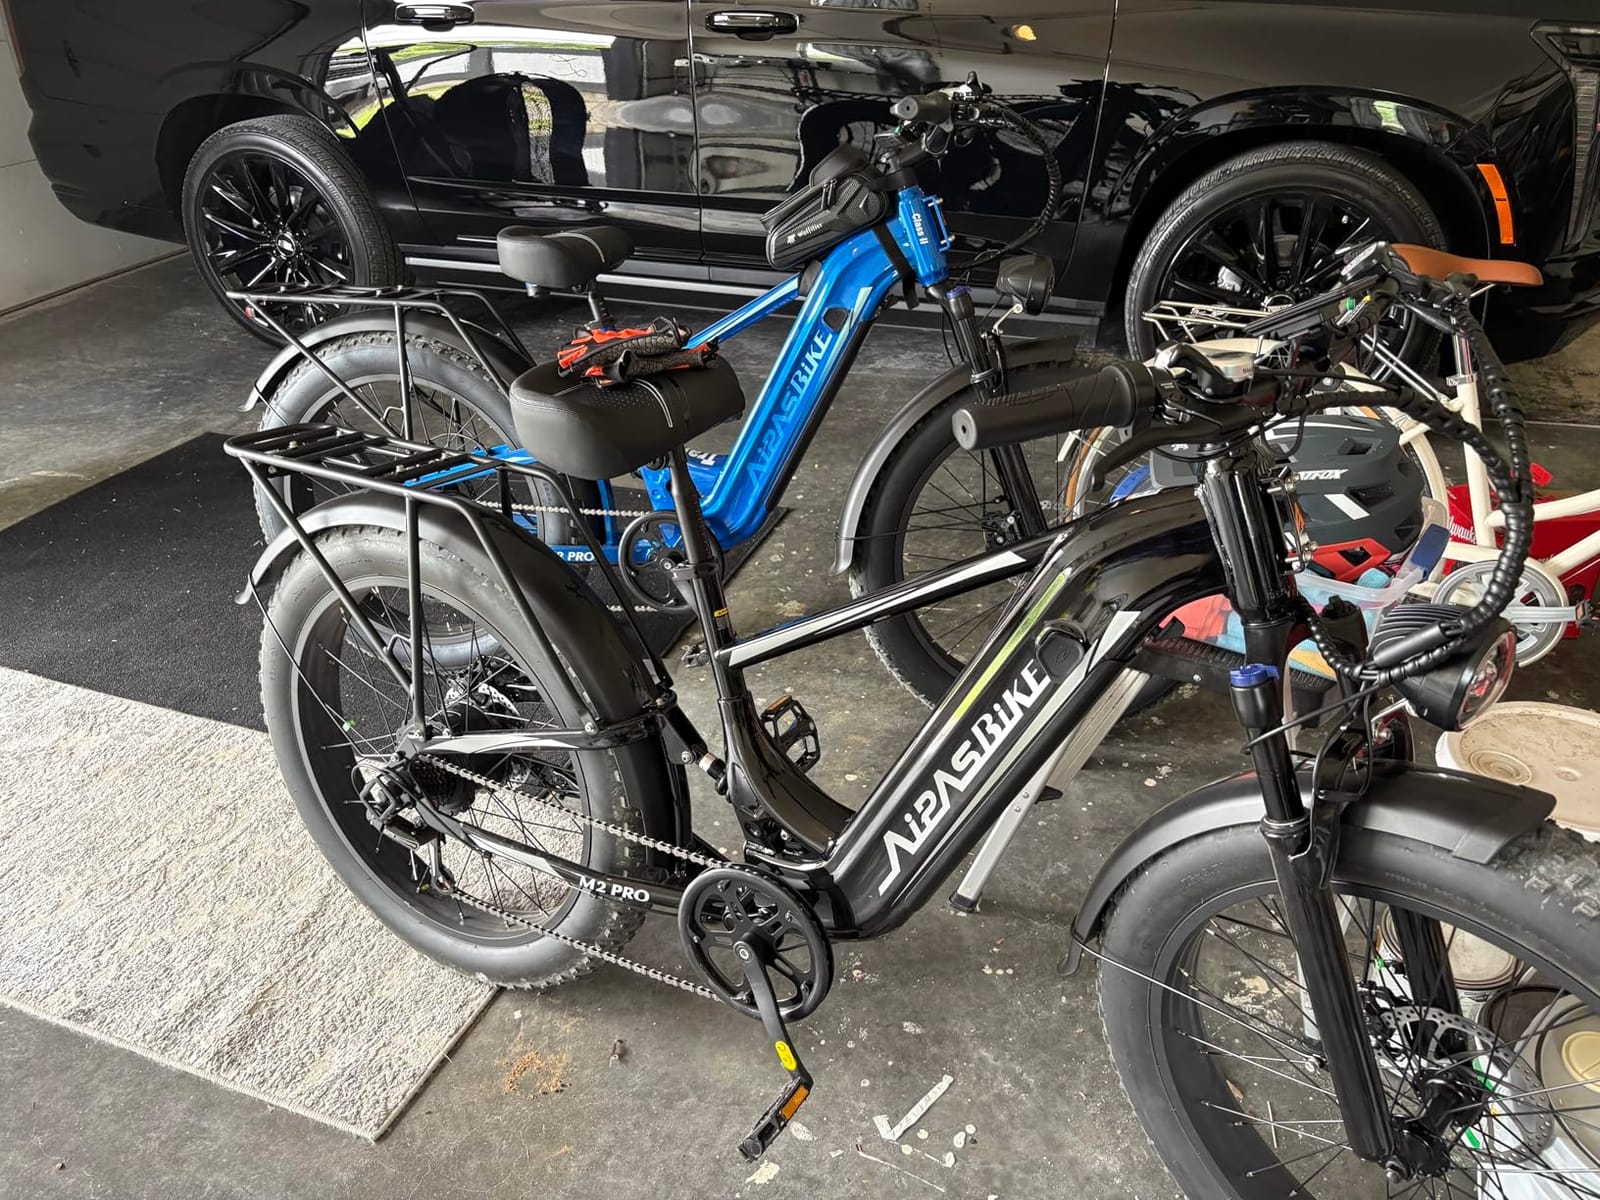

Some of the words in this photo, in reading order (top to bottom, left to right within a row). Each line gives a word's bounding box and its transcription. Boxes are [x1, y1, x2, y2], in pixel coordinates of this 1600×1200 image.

[912, 213, 924, 237] Class
[567, 551, 595, 562] PRO
[579, 875, 607, 894] M2
[610, 883, 650, 903] PRO
